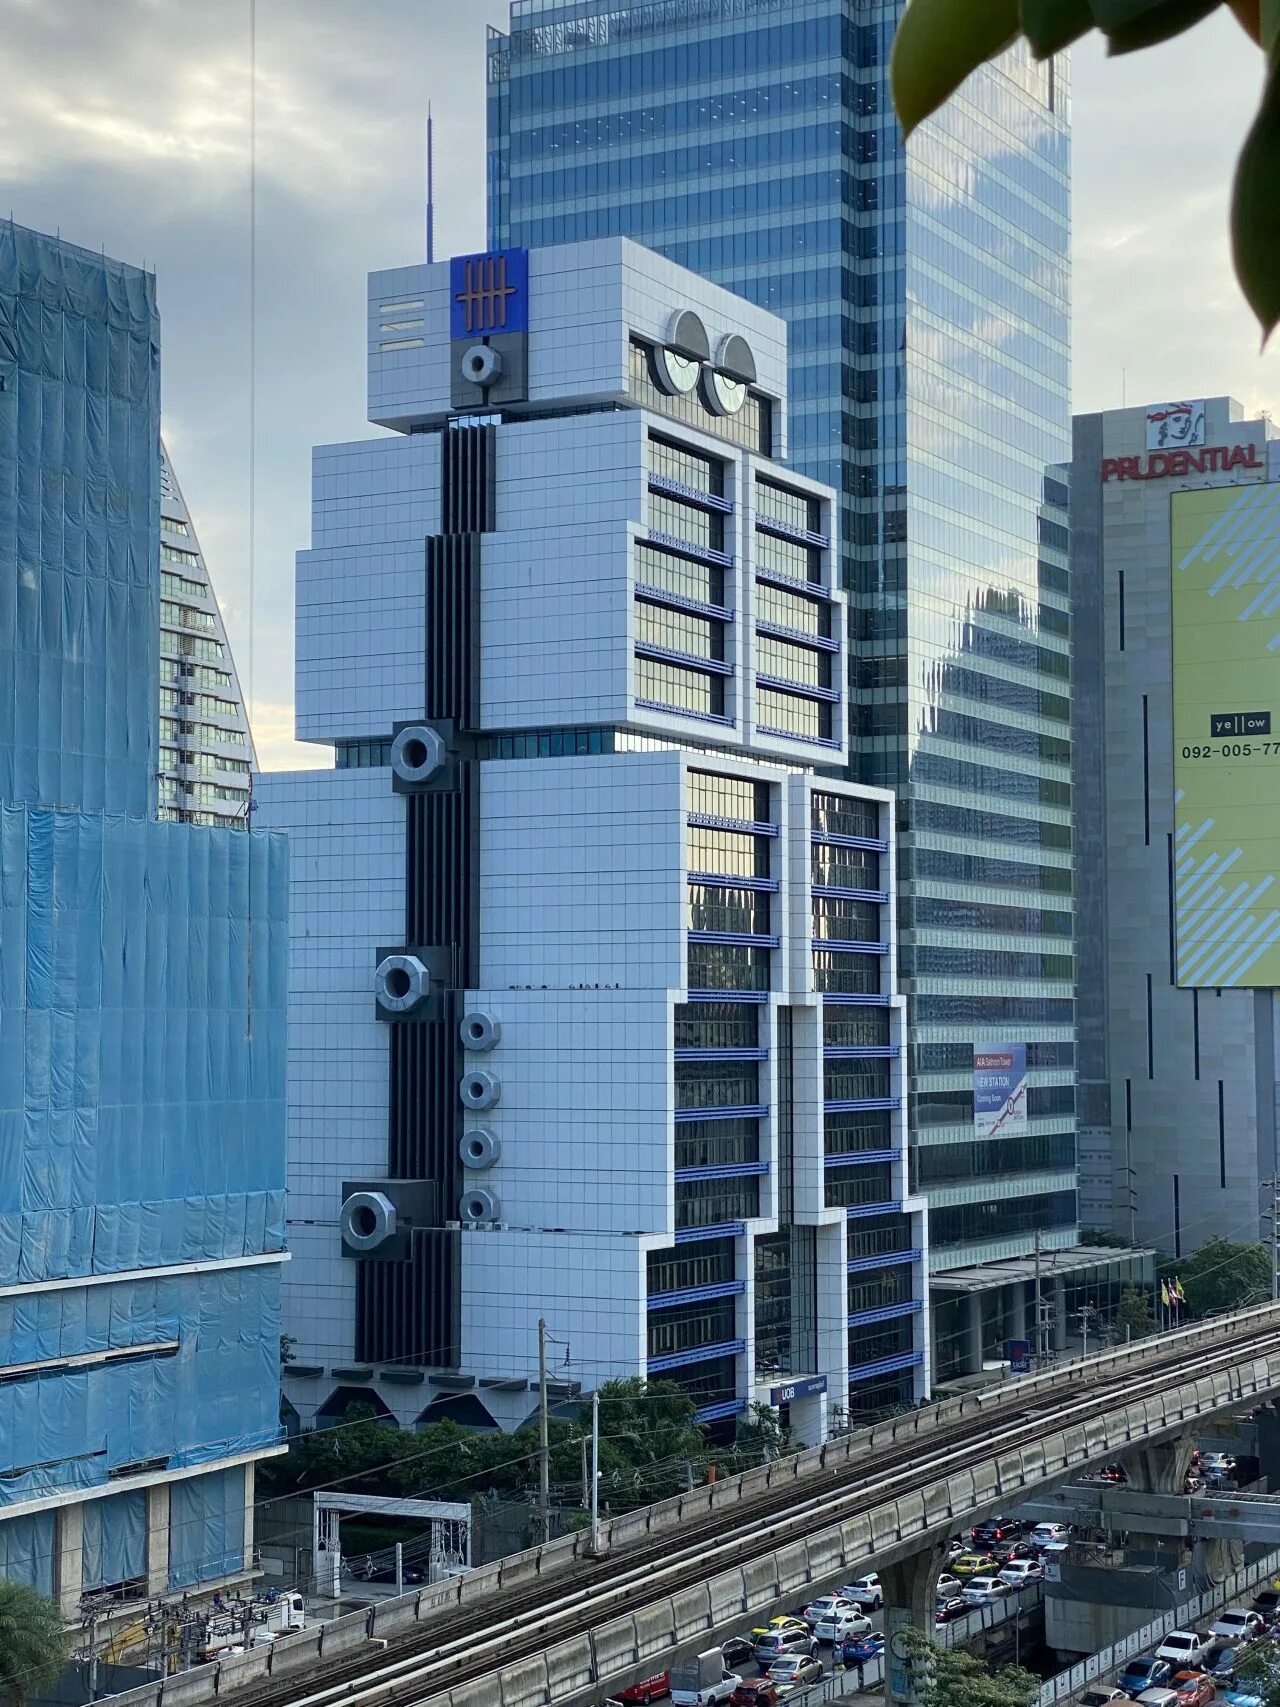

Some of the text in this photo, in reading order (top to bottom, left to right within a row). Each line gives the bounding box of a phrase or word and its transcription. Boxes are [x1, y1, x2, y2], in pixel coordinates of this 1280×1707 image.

[1102, 443, 1263, 482] PRUDENTIAL
[977, 1057, 985, 1067] AIA
[989, 1076, 1010, 1088] STATION
[976, 1094, 1001, 1103] Coming Soon
[782, 1386, 795, 1400] UOB
